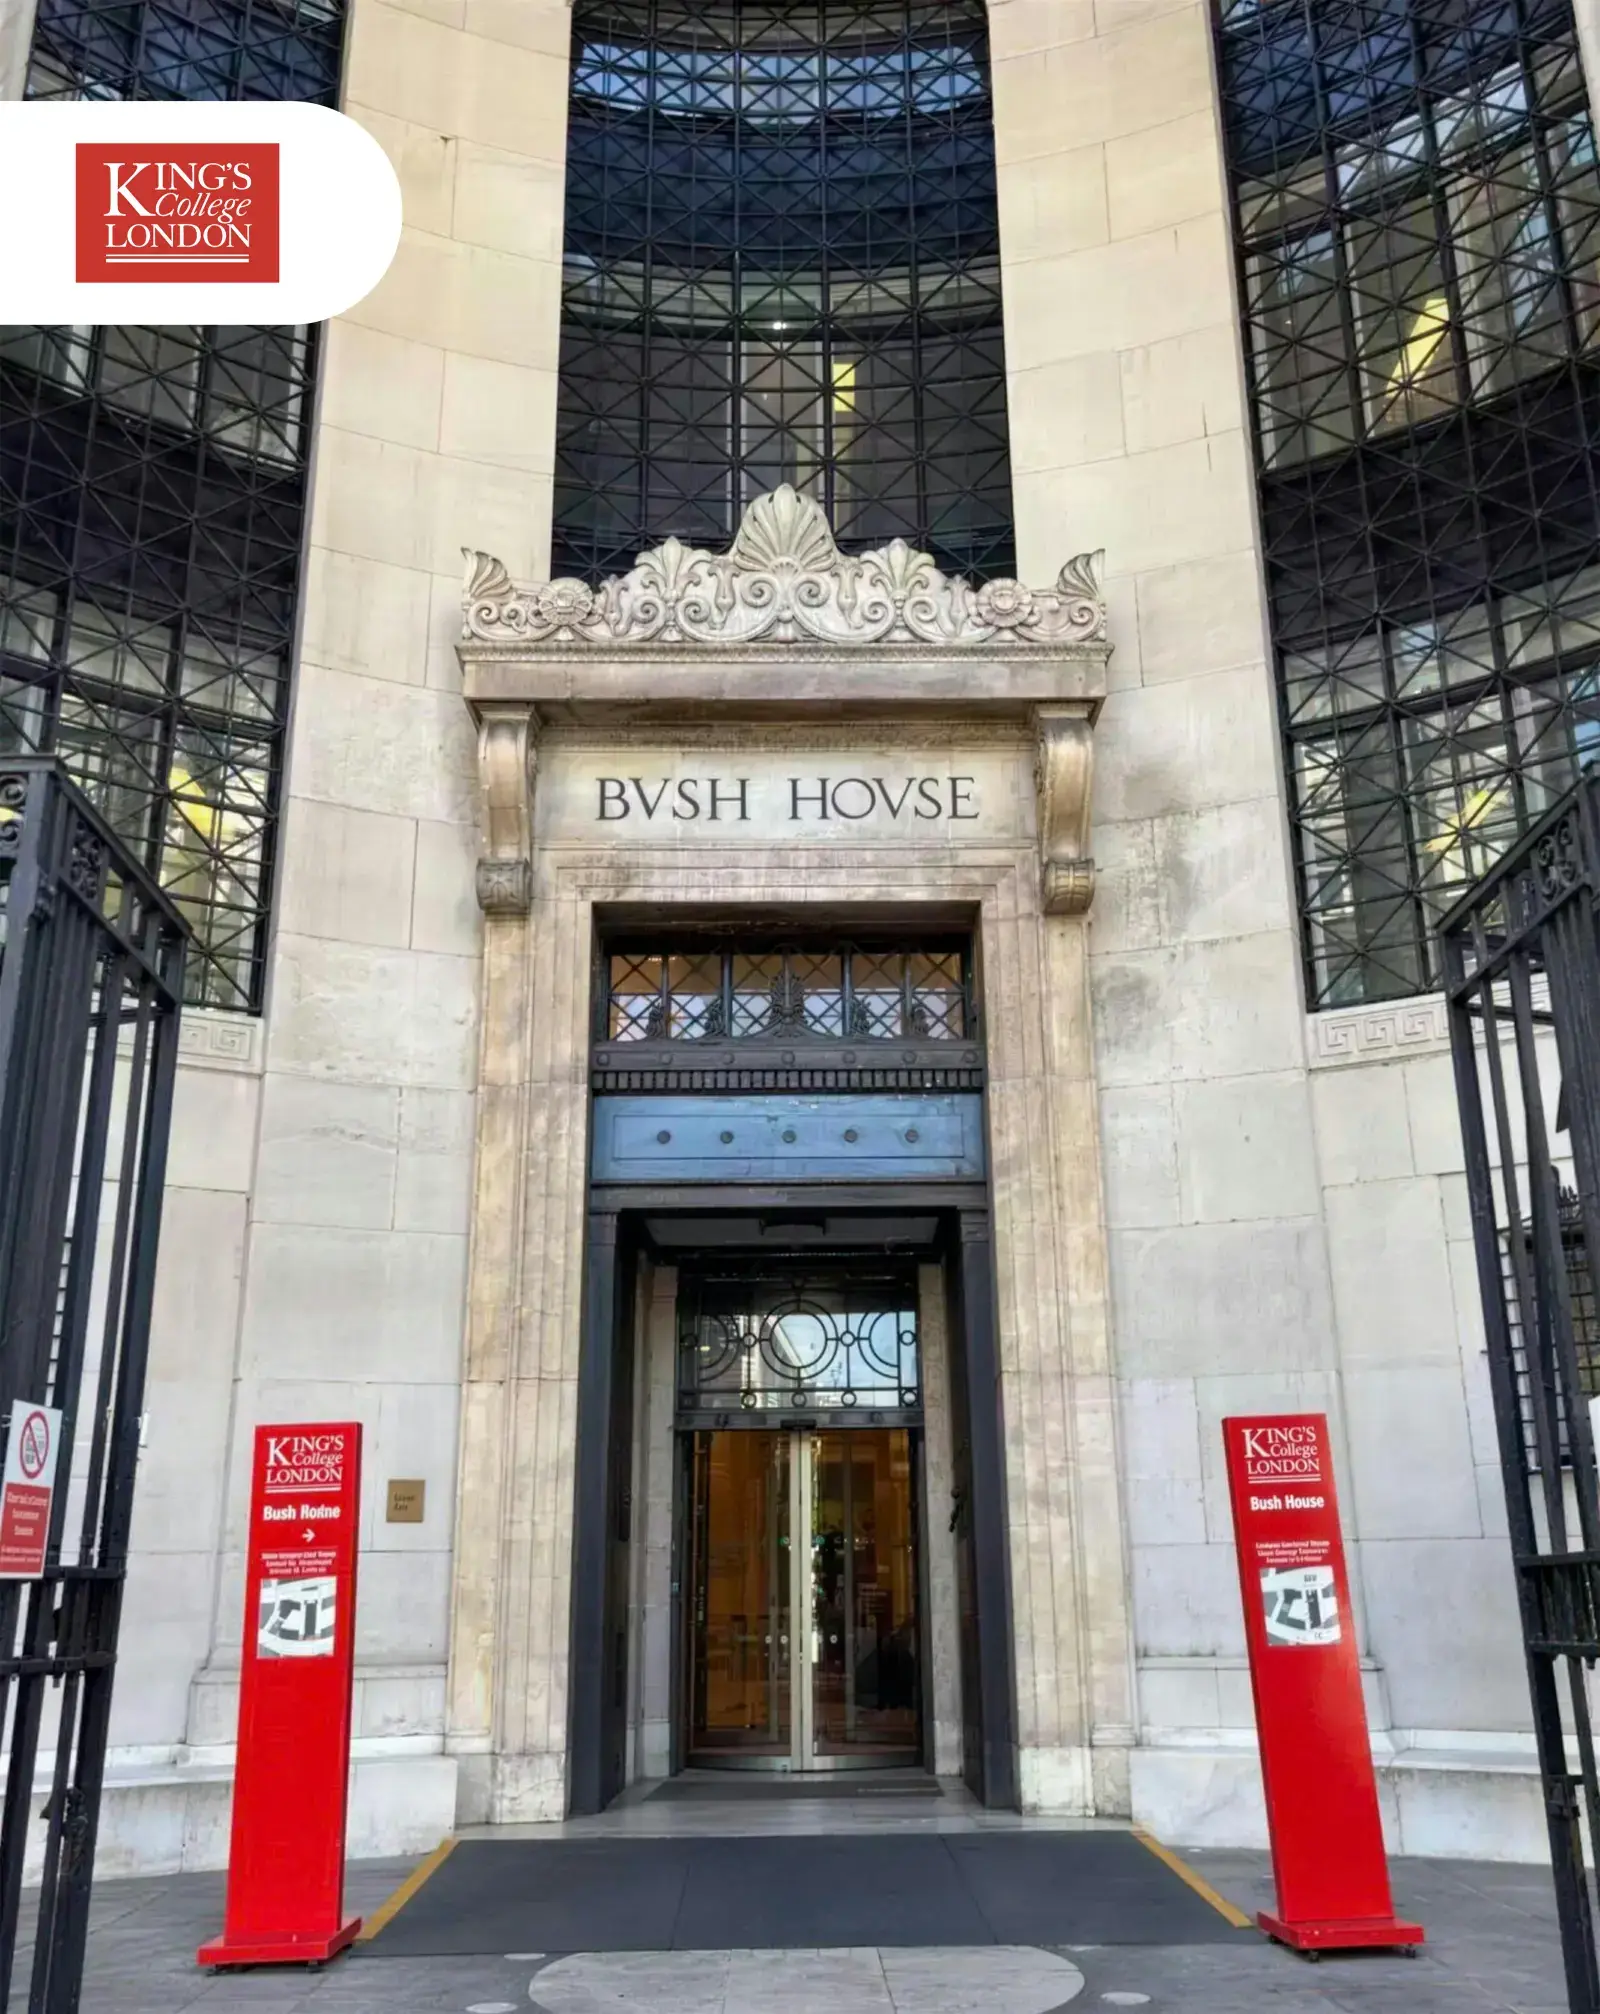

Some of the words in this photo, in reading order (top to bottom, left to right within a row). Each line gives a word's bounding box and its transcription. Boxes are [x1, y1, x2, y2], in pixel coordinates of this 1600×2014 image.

[595, 777, 751, 821] BVSH
[788, 776, 980, 820] HOVSE
[292, 1452, 344, 1467] College
[1270, 1443, 1318, 1459] College
[265, 1466, 344, 1484] LONDON
[1246, 1458, 1320, 1475] LONDON
[1250, 1496, 1282, 1511] Bush
[1285, 1494, 1325, 1509] House
[263, 1504, 297, 1521] Bush
